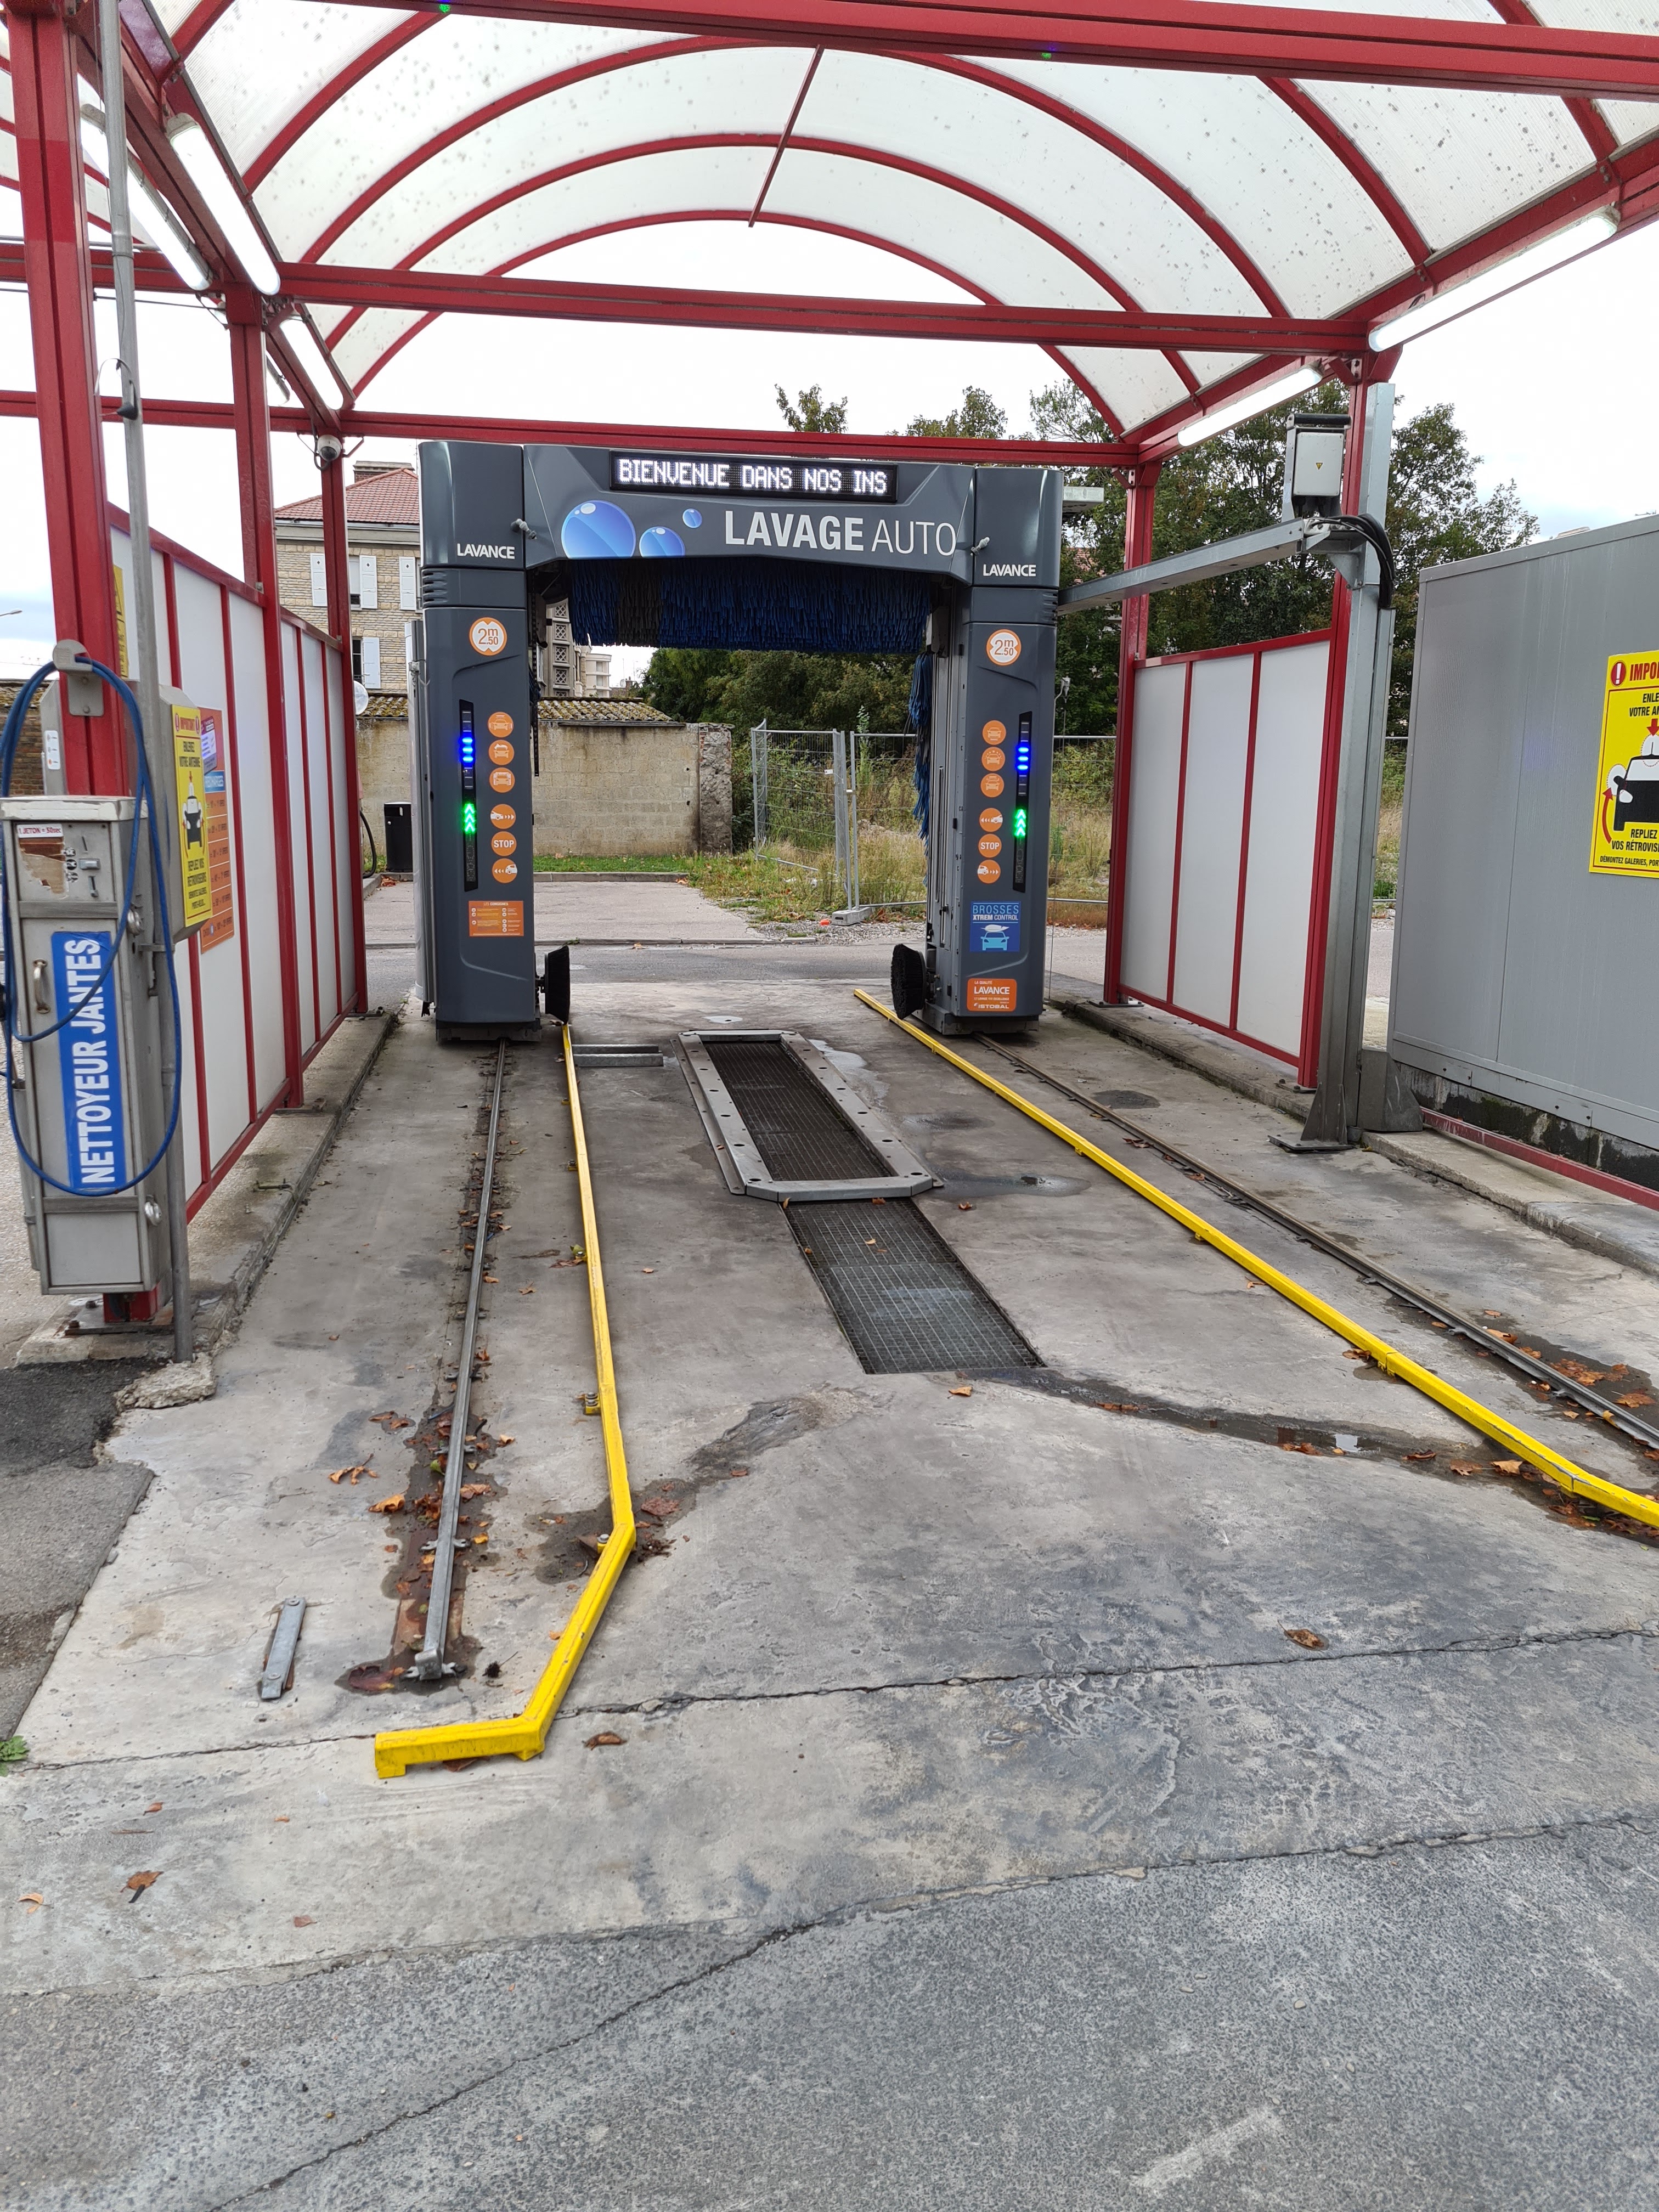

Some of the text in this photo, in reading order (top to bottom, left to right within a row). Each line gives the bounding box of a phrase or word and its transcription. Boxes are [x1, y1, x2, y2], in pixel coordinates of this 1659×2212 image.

[618, 459, 887, 493] BIENVENUE DANS NOS INS
[725, 510, 956, 556] LAVAGE AUTO
[457, 543, 515, 560] LAVANCE
[983, 564, 1036, 577] LAVANCE
[1629, 661, 1659, 681] IMPO
[1629, 706, 1650, 717] VOTRE
[1630, 828, 1658, 839] REPLIEZ
[493, 839, 515, 848] STOP
[1612, 839, 1659, 853] VOS RÉTROVIS
[1600, 855, 1624, 864] DÉMONTEZ
[1624, 857, 1647, 867] GALERIES,
[973, 905, 1019, 914] BROSSES
[974, 986, 1010, 995] LAVANCE
[64, 940, 115, 1184] NETTOYEUR JANTES
